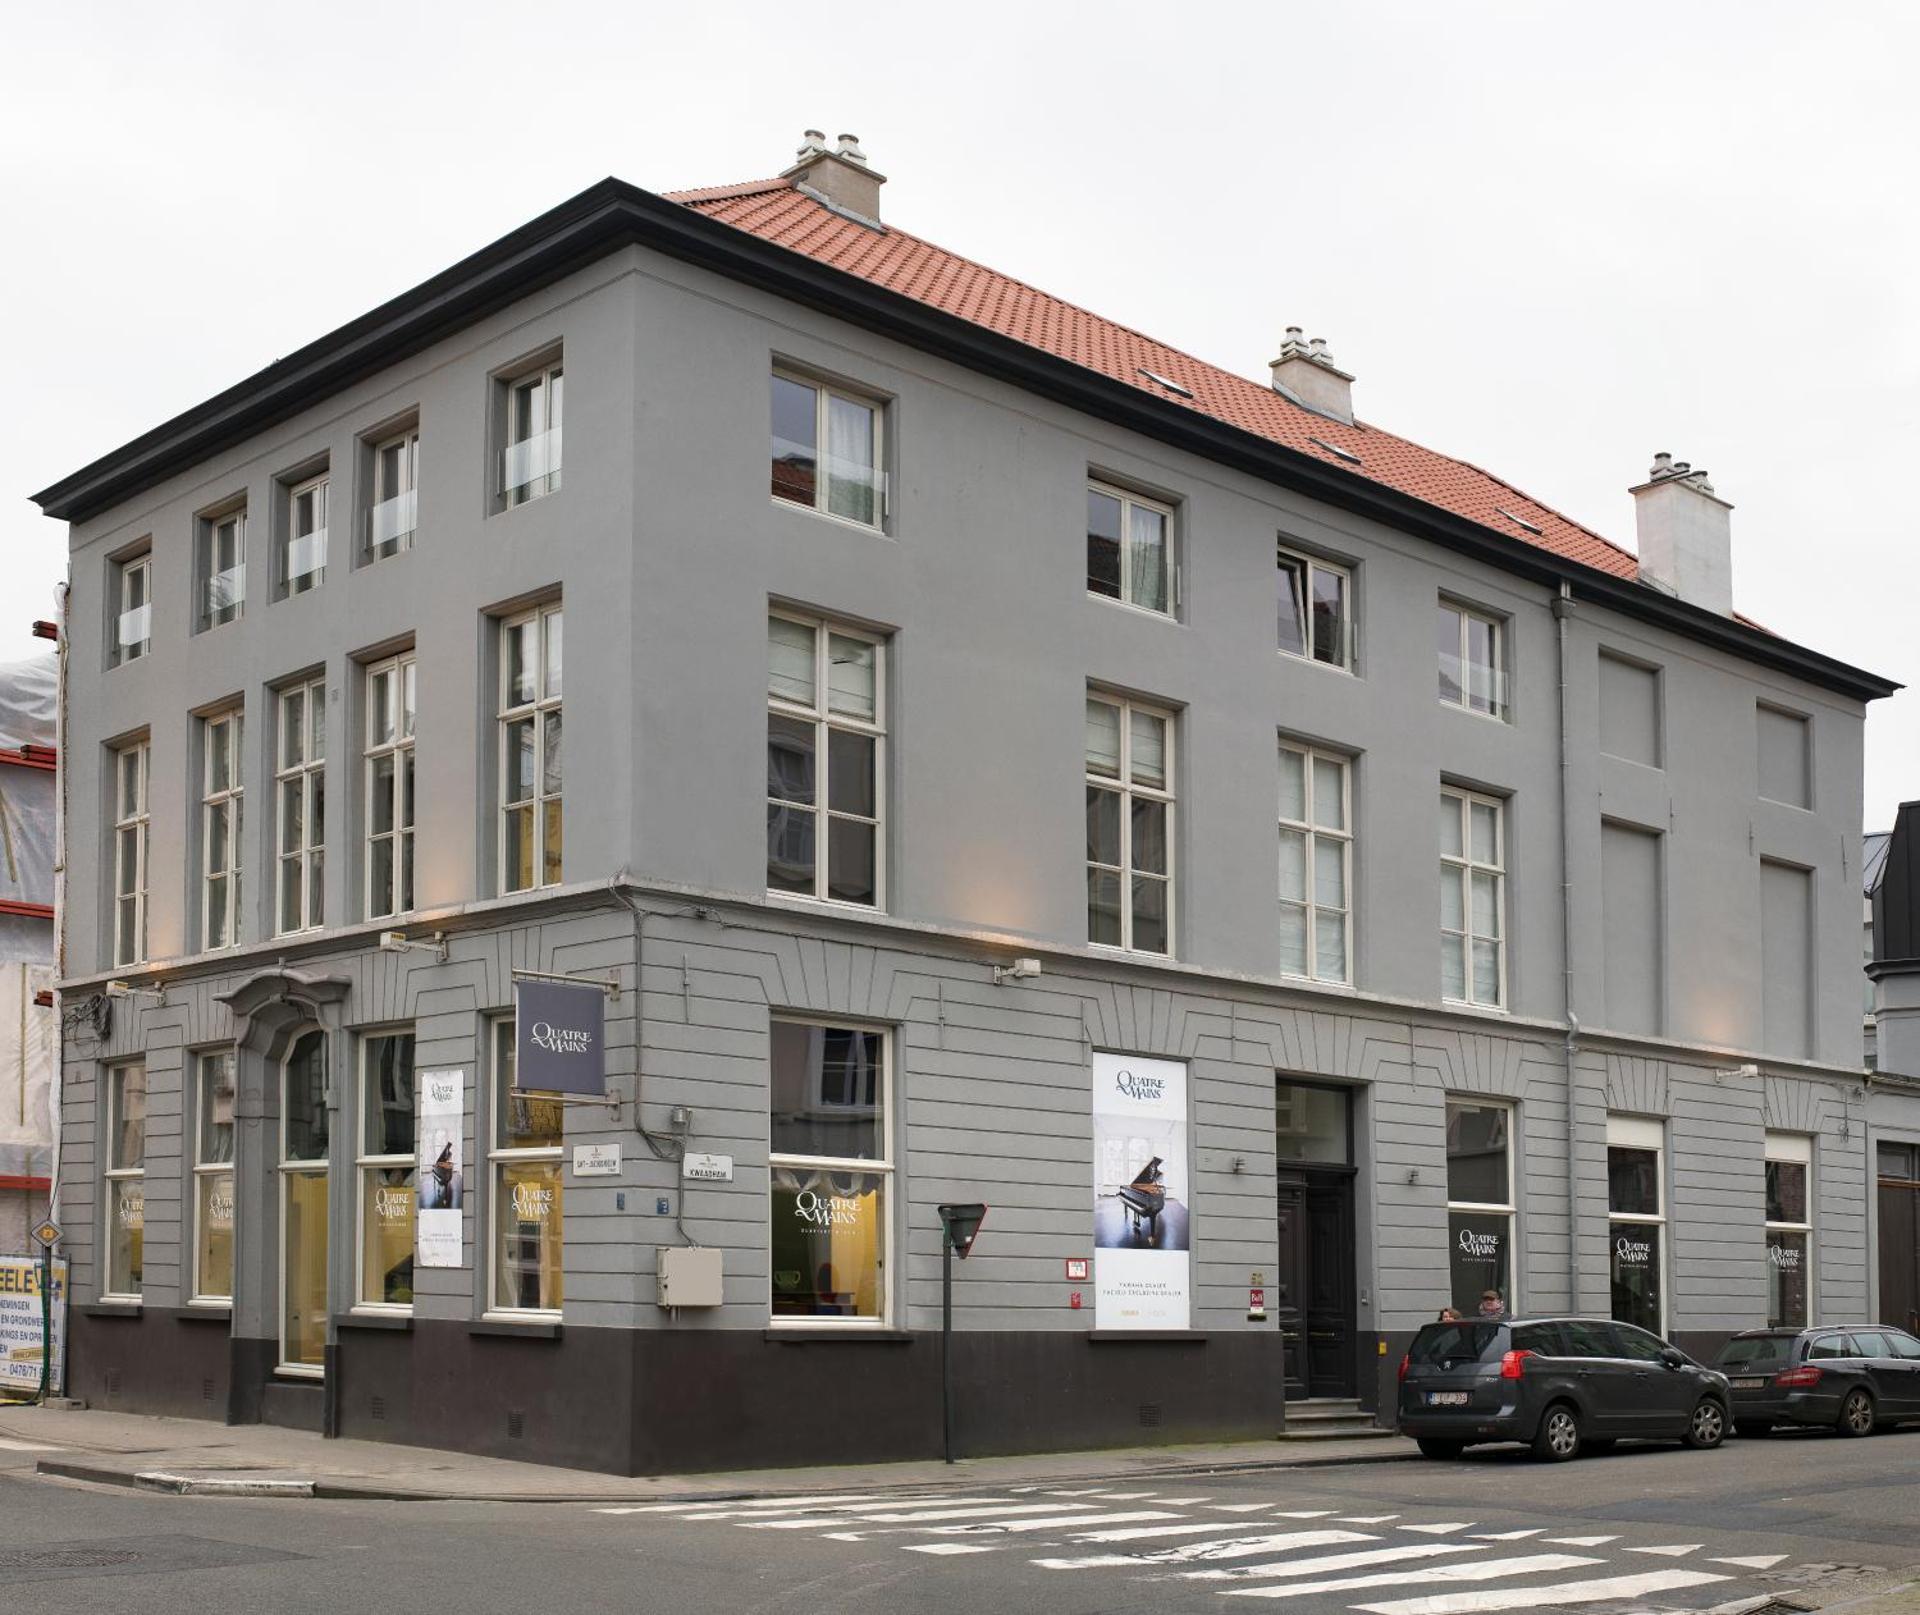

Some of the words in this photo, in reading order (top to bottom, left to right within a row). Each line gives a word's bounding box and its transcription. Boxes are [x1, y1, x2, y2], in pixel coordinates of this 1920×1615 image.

[531, 1022, 592, 1048] QUATRE
[549, 1038, 587, 1052] MAINS
[1116, 1070, 1165, 1096] QUATRE
[1130, 1085, 1161, 1100] MAINS
[376, 1188, 408, 1216] QUATRE
[512, 1184, 552, 1214] QUATRE
[795, 1191, 862, 1221] QUATRE
[385, 1203, 407, 1219] MAINS
[524, 1201, 549, 1217] MAINS
[815, 1209, 856, 1225] MAINS
[1459, 1230, 1499, 1252] QUATRE
[1471, 1243, 1496, 1256] MAINS
[1616, 1238, 1650, 1260] QUATRE
[1627, 1250, 1648, 1262] MAINS
